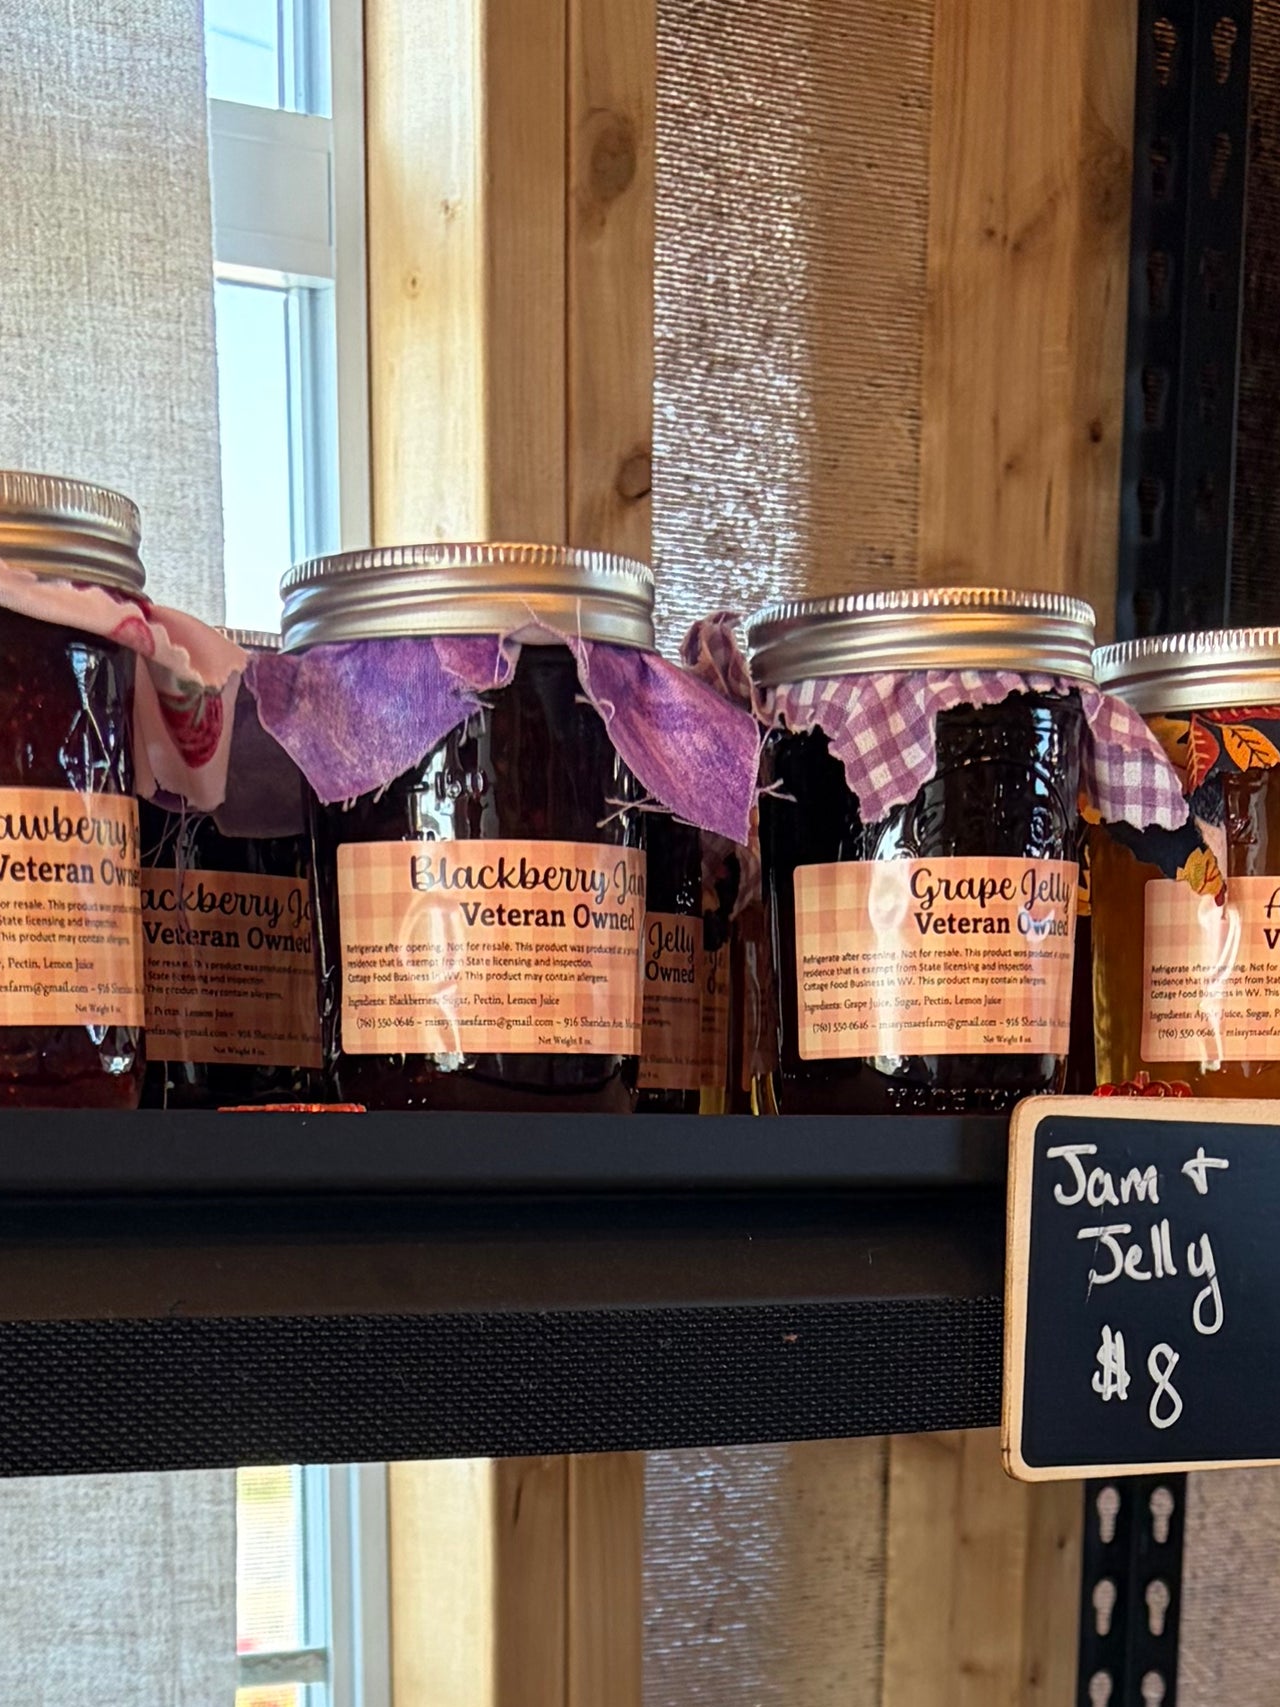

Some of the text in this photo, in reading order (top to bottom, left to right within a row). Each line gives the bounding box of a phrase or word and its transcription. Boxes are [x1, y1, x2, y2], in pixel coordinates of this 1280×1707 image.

[409, 855, 610, 905] Blackberry
[909, 867, 1072, 913] Grape Jelly
[142, 883, 286, 930] ackberry
[459, 902, 635, 931] Veteran Owned
[914, 911, 1069, 937] Veteran Owned
[145, 919, 312, 955] Veteran Owned
[648, 920, 696, 962] Jelly
[644, 960, 696, 985] Owned
[1046, 1143, 1160, 1207] Jam
[1076, 1218, 1224, 1336] Jelly
